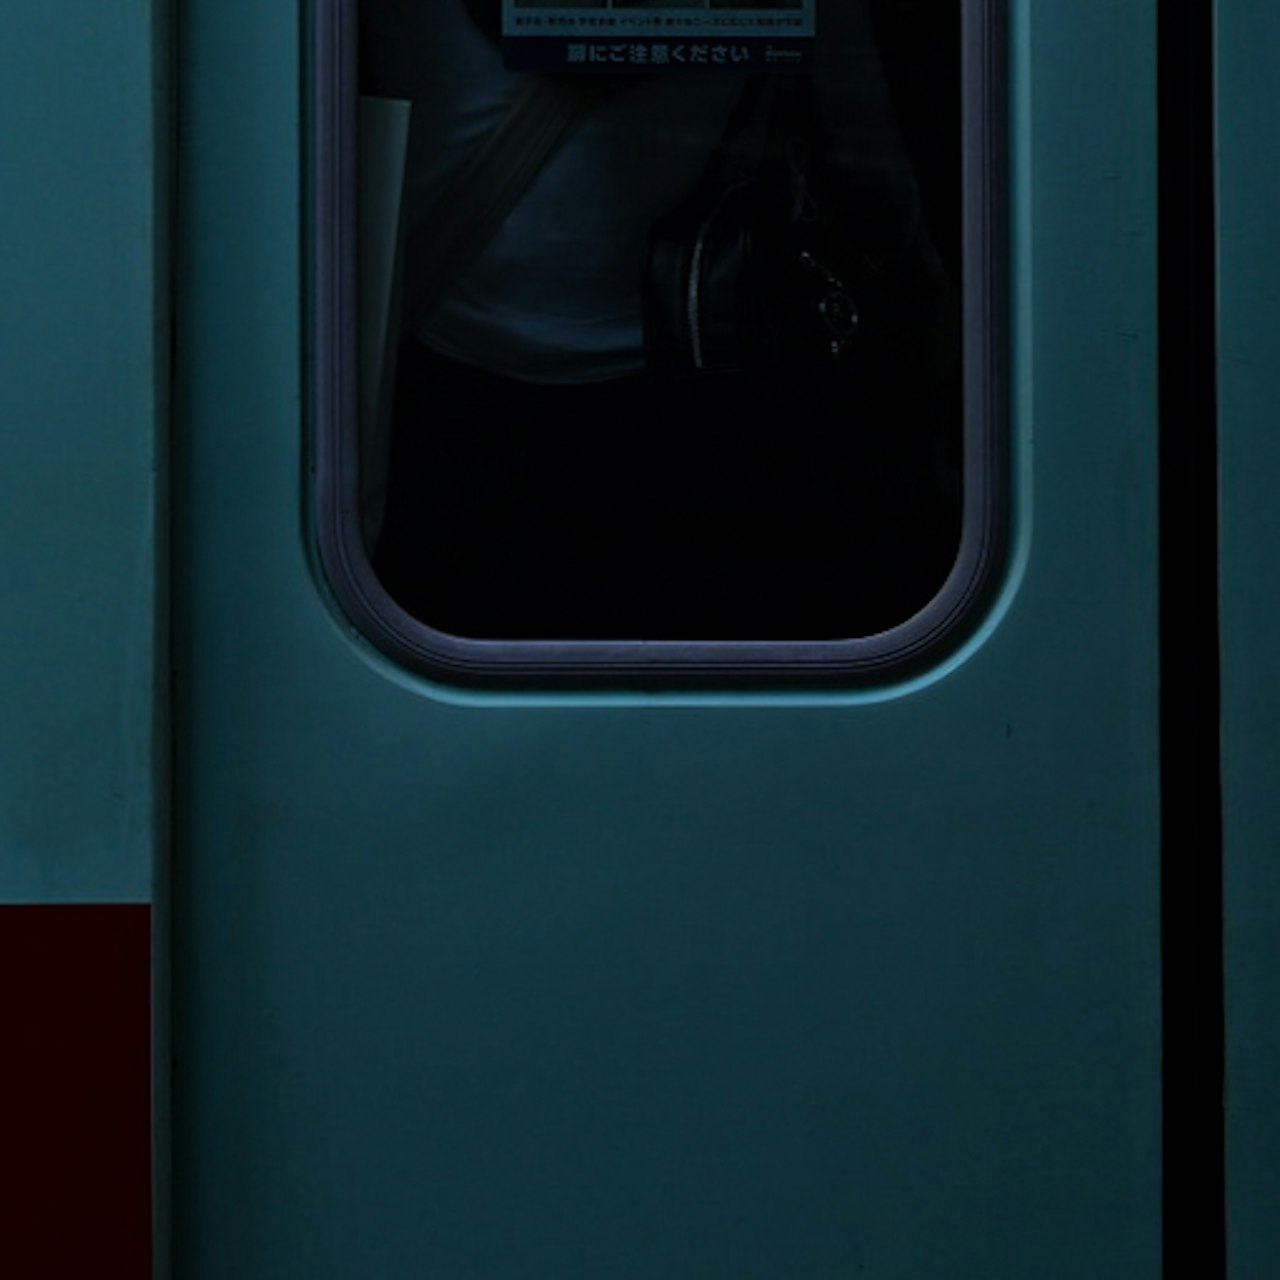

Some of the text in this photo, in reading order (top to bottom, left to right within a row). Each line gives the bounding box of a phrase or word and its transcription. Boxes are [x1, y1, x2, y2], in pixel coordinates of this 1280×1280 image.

[567, 43, 750, 64] 扉にご注意ください
